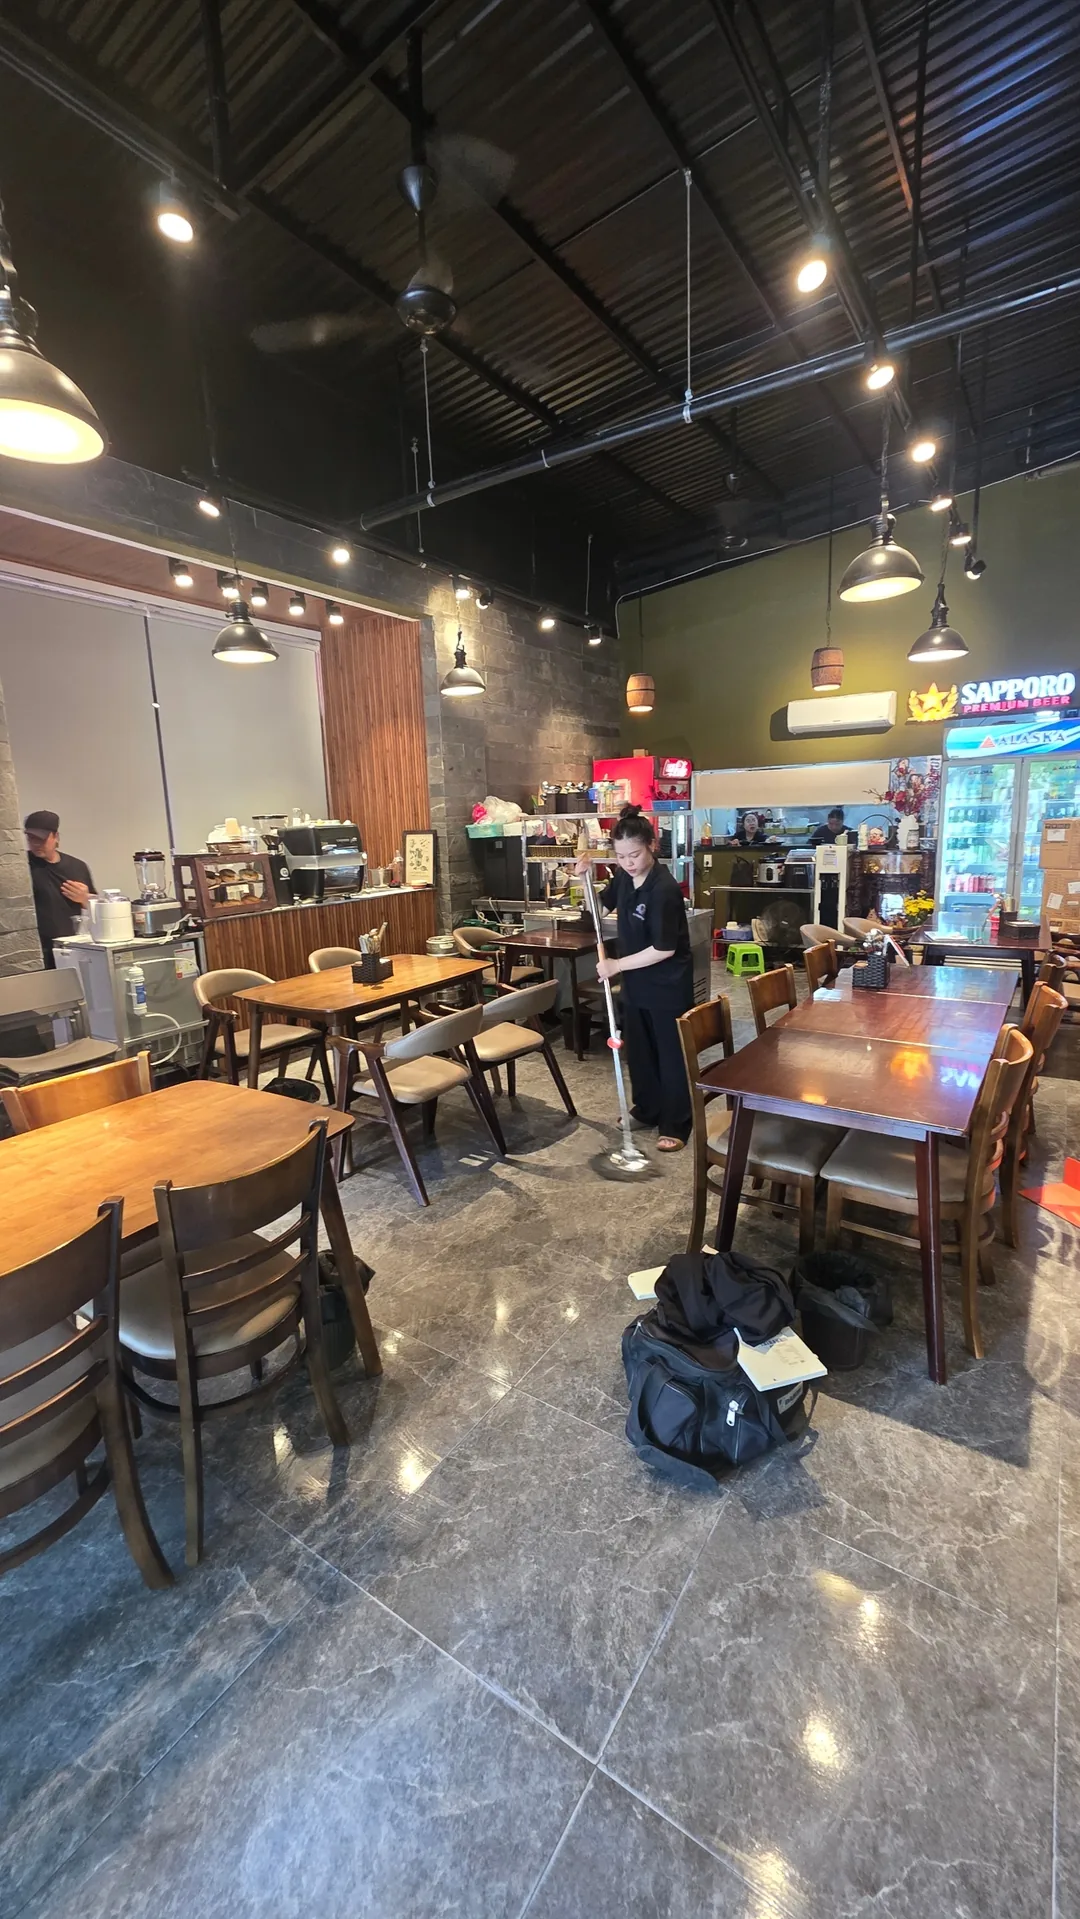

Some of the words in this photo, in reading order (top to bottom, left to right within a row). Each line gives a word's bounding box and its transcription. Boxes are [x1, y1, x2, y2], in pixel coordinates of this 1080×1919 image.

[961, 672, 1076, 705] SAPPORO
[962, 699, 1029, 714] PREMIUM
[1032, 696, 1071, 707] BEER
[998, 730, 1066, 746] ALASKA
